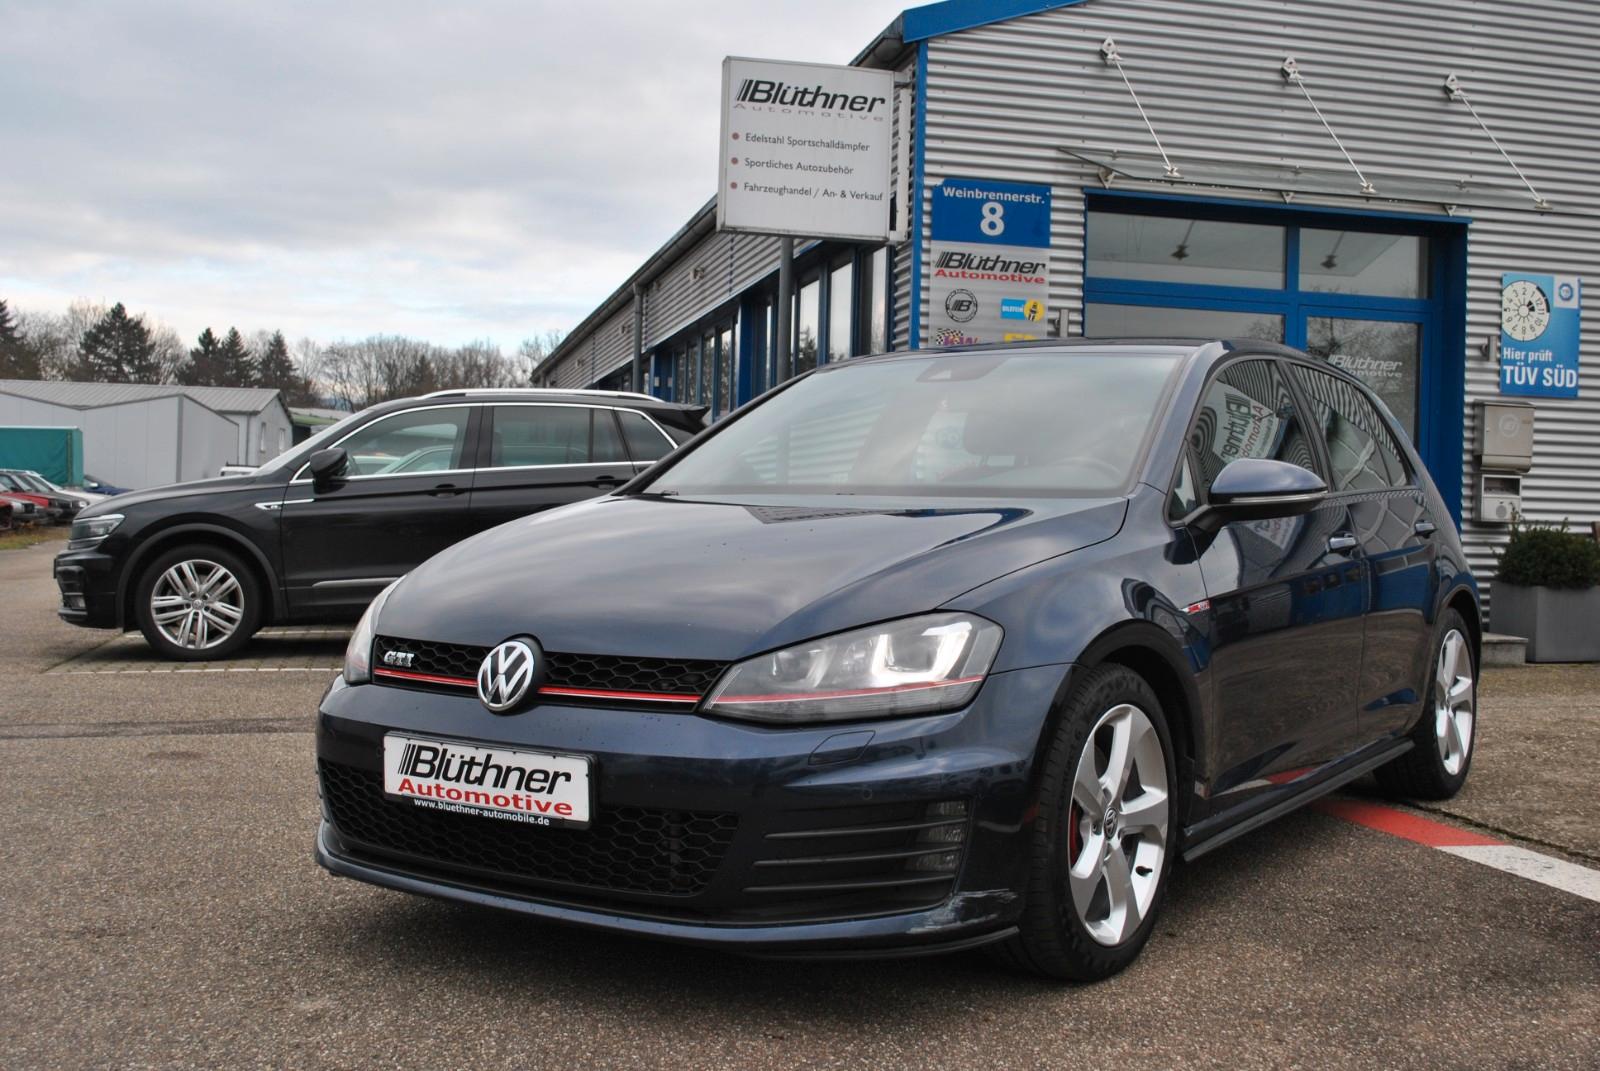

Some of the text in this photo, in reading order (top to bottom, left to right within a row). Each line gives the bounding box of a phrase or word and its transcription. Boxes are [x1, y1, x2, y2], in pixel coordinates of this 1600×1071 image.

[736, 79, 886, 113] Blüthner
[733, 103, 883, 122] Automotive
[745, 133, 870, 152] Edelstahl Sportschalldämpfer
[744, 158, 854, 174] Sportliches Autozubehör
[744, 183, 812, 197] Fahrzeughandel
[850, 191, 883, 201] Verkauf
[943, 186, 1045, 204] Weinbrennerstr.
[980, 201, 1005, 236] 8
[935, 251, 1046, 274] Blüthner
[934, 268, 1045, 284] Automotive
[1503, 347, 1552, 363] Hier prüft
[1503, 362, 1577, 388] TÜV SÜD
[384, 650, 414, 667] GTI
[398, 743, 572, 795] Blüthner
[398, 778, 573, 816] Automotive
[414, 799, 550, 826] www.bluethner-automobile.de
